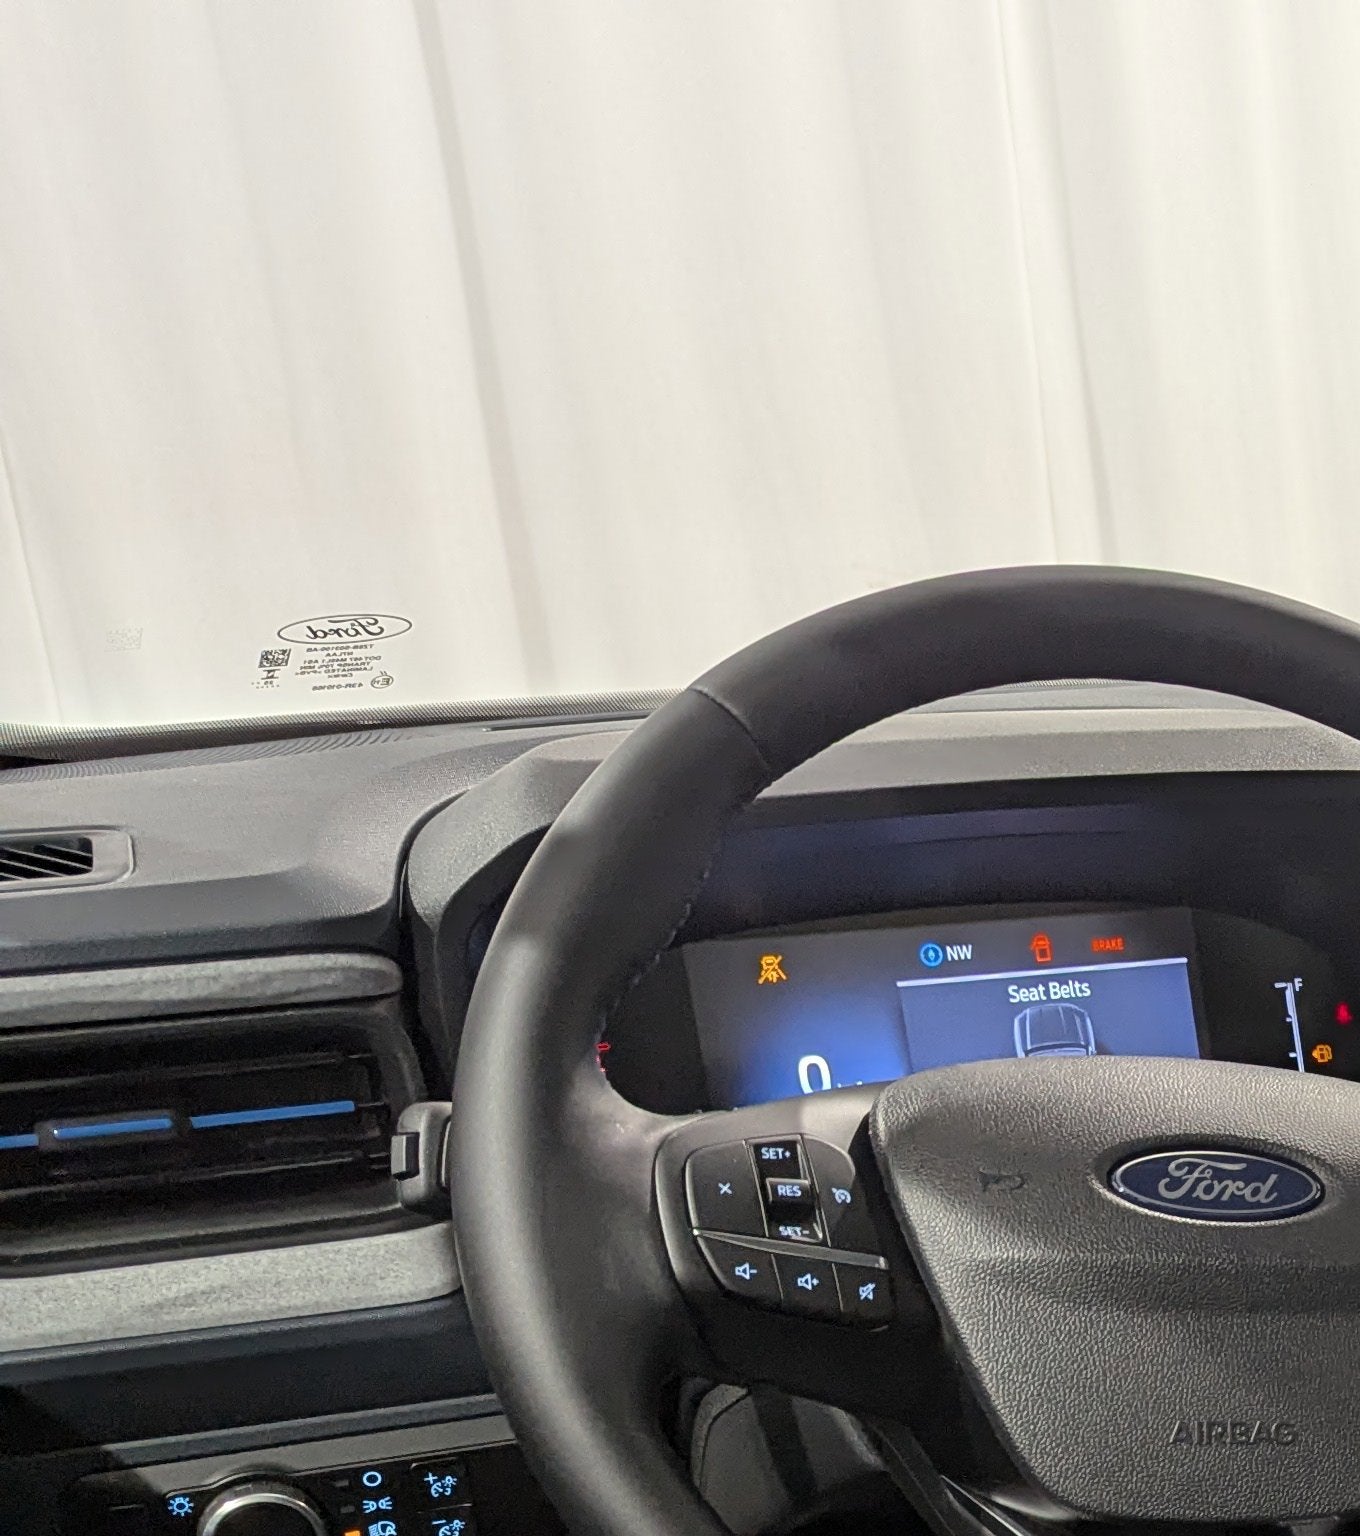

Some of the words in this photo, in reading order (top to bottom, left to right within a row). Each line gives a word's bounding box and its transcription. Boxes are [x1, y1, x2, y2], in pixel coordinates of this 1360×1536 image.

[946, 944, 972, 962] NW
[1091, 937, 1124, 952] BRAKE
[1007, 984, 1046, 1003] Seat
[1049, 980, 1091, 1000] Belts
[1293, 977, 1303, 992] F
[1158, 1157, 1278, 1204] Ford
[777, 1184, 802, 1197] RES
[1169, 1419, 1297, 1446] AIRBAG
